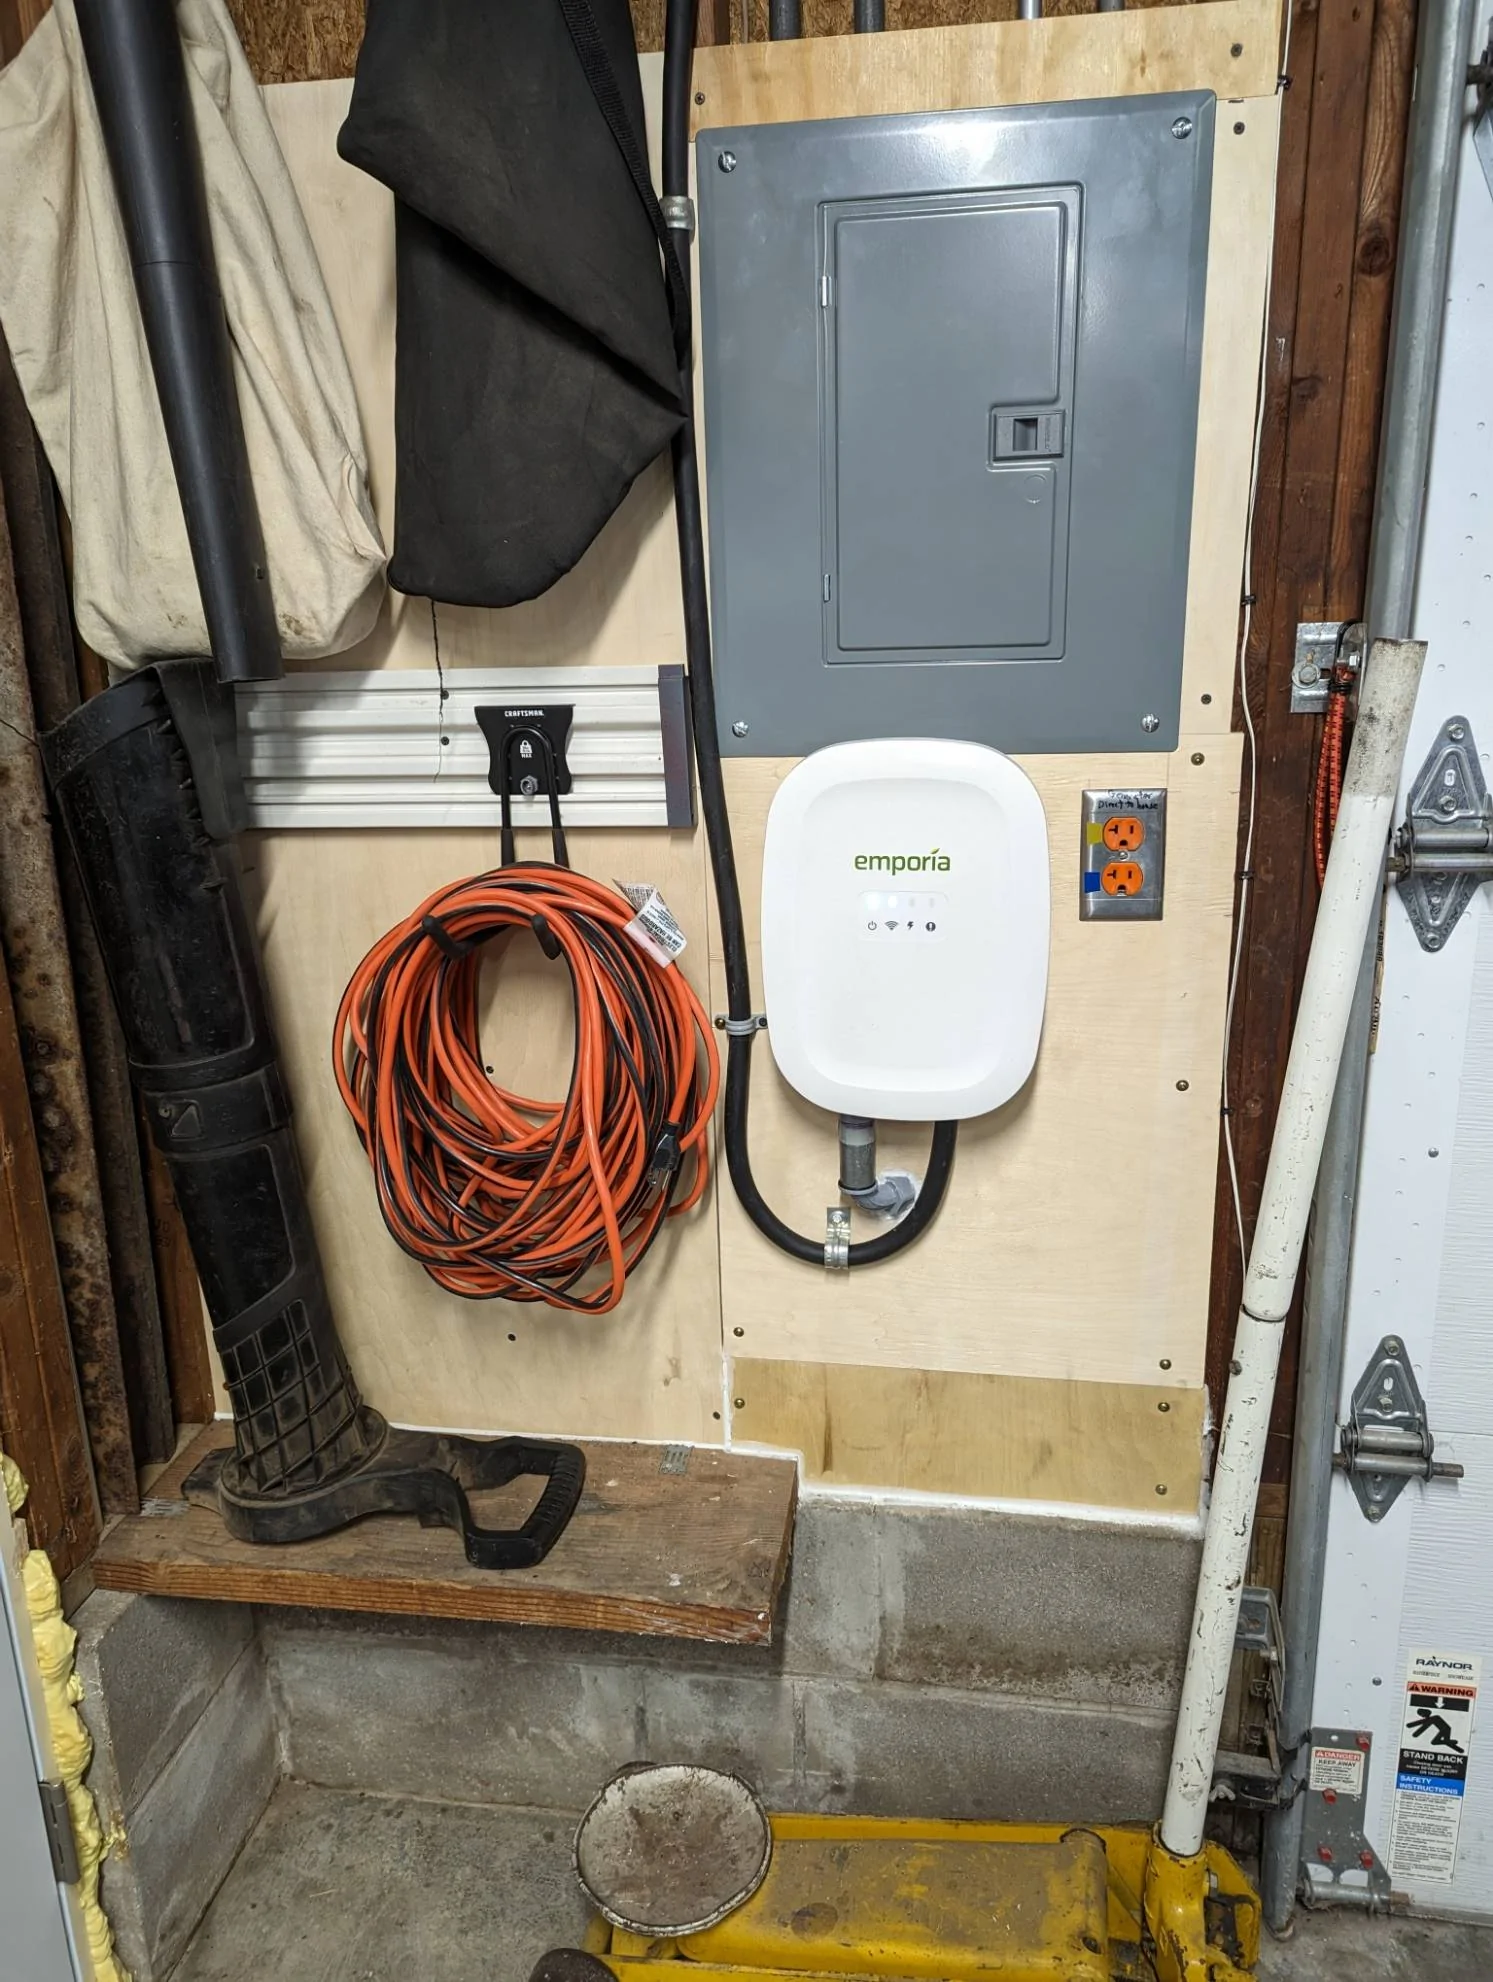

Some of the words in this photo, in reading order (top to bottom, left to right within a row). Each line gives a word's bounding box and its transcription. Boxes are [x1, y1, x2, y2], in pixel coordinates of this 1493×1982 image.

[854, 847, 951, 876] emporia
[1415, 1658, 1473, 1670] RAYNOR
[1421, 1685, 1474, 1697] WARNING
[1324, 1751, 1360, 1761] DANGER
[1403, 1751, 1435, 1761] STAND
[1437, 1754, 1464, 1764] BACK
[1400, 1775, 1431, 1784] SAFETY
[1400, 1782, 1458, 1795] INSTRUCTIONS
